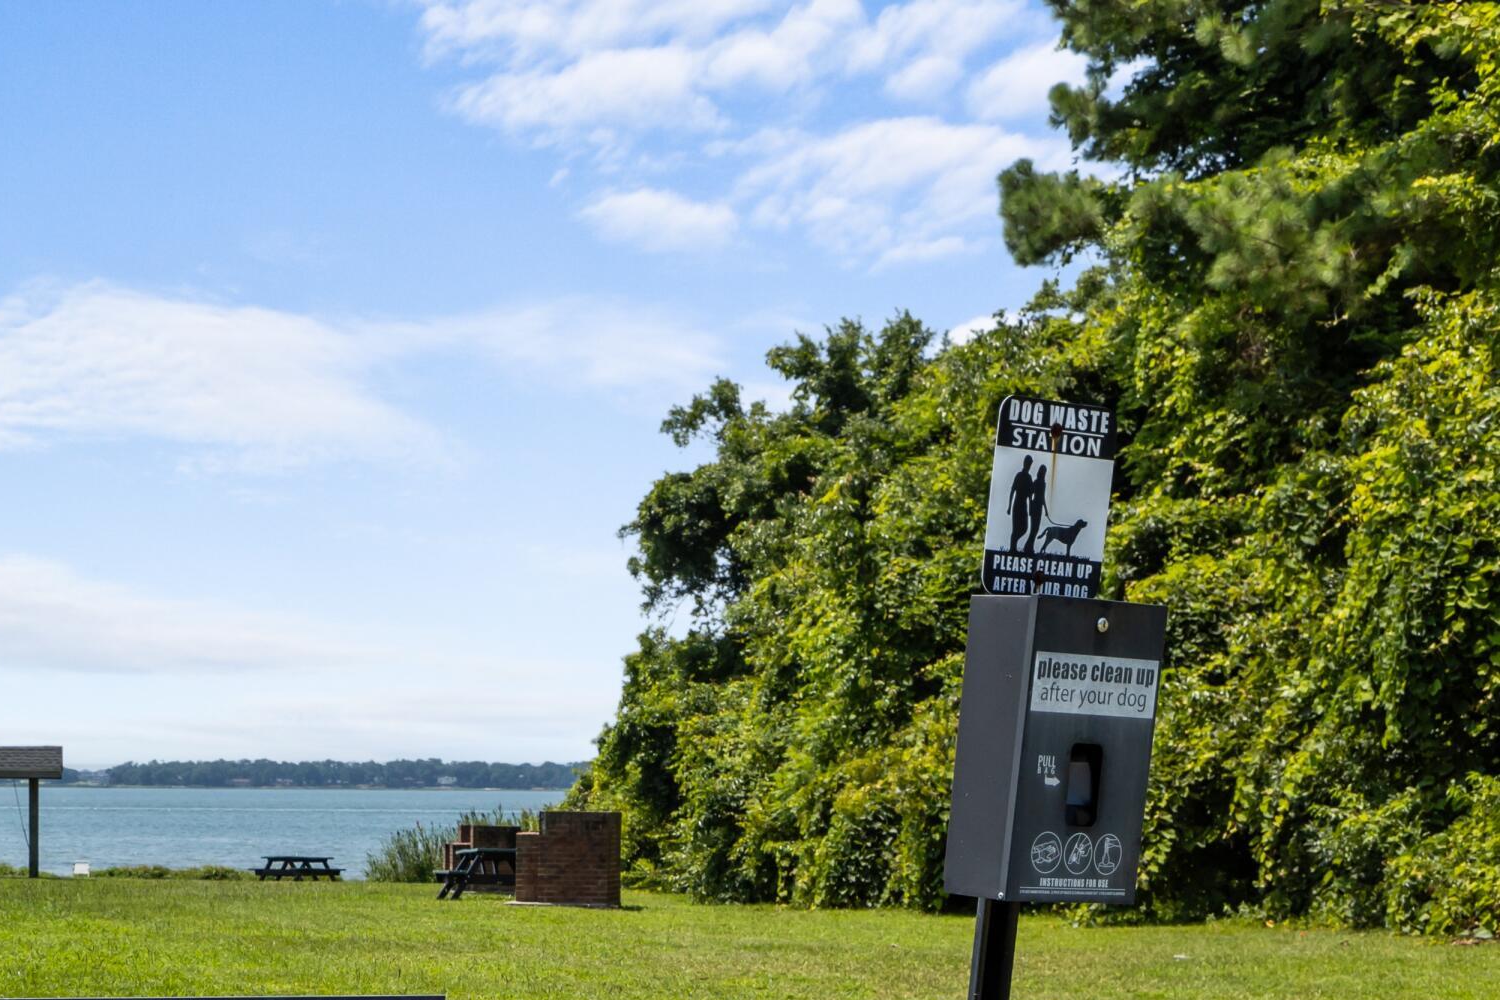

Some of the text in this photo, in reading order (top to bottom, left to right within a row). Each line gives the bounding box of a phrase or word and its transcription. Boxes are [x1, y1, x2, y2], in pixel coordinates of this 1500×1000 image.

[1009, 399, 1110, 433] DOG WASTE
[993, 554, 1093, 579] PLEASE CLEAN UP
[993, 576, 1026, 593] AFTER
[1064, 583, 1089, 598] DOG
[1037, 658, 1155, 688] please clean up
[1040, 681, 1147, 712] after your dog
[1037, 754, 1056, 767] PULL
[1039, 877, 1085, 888] INSTRUCTIONS
